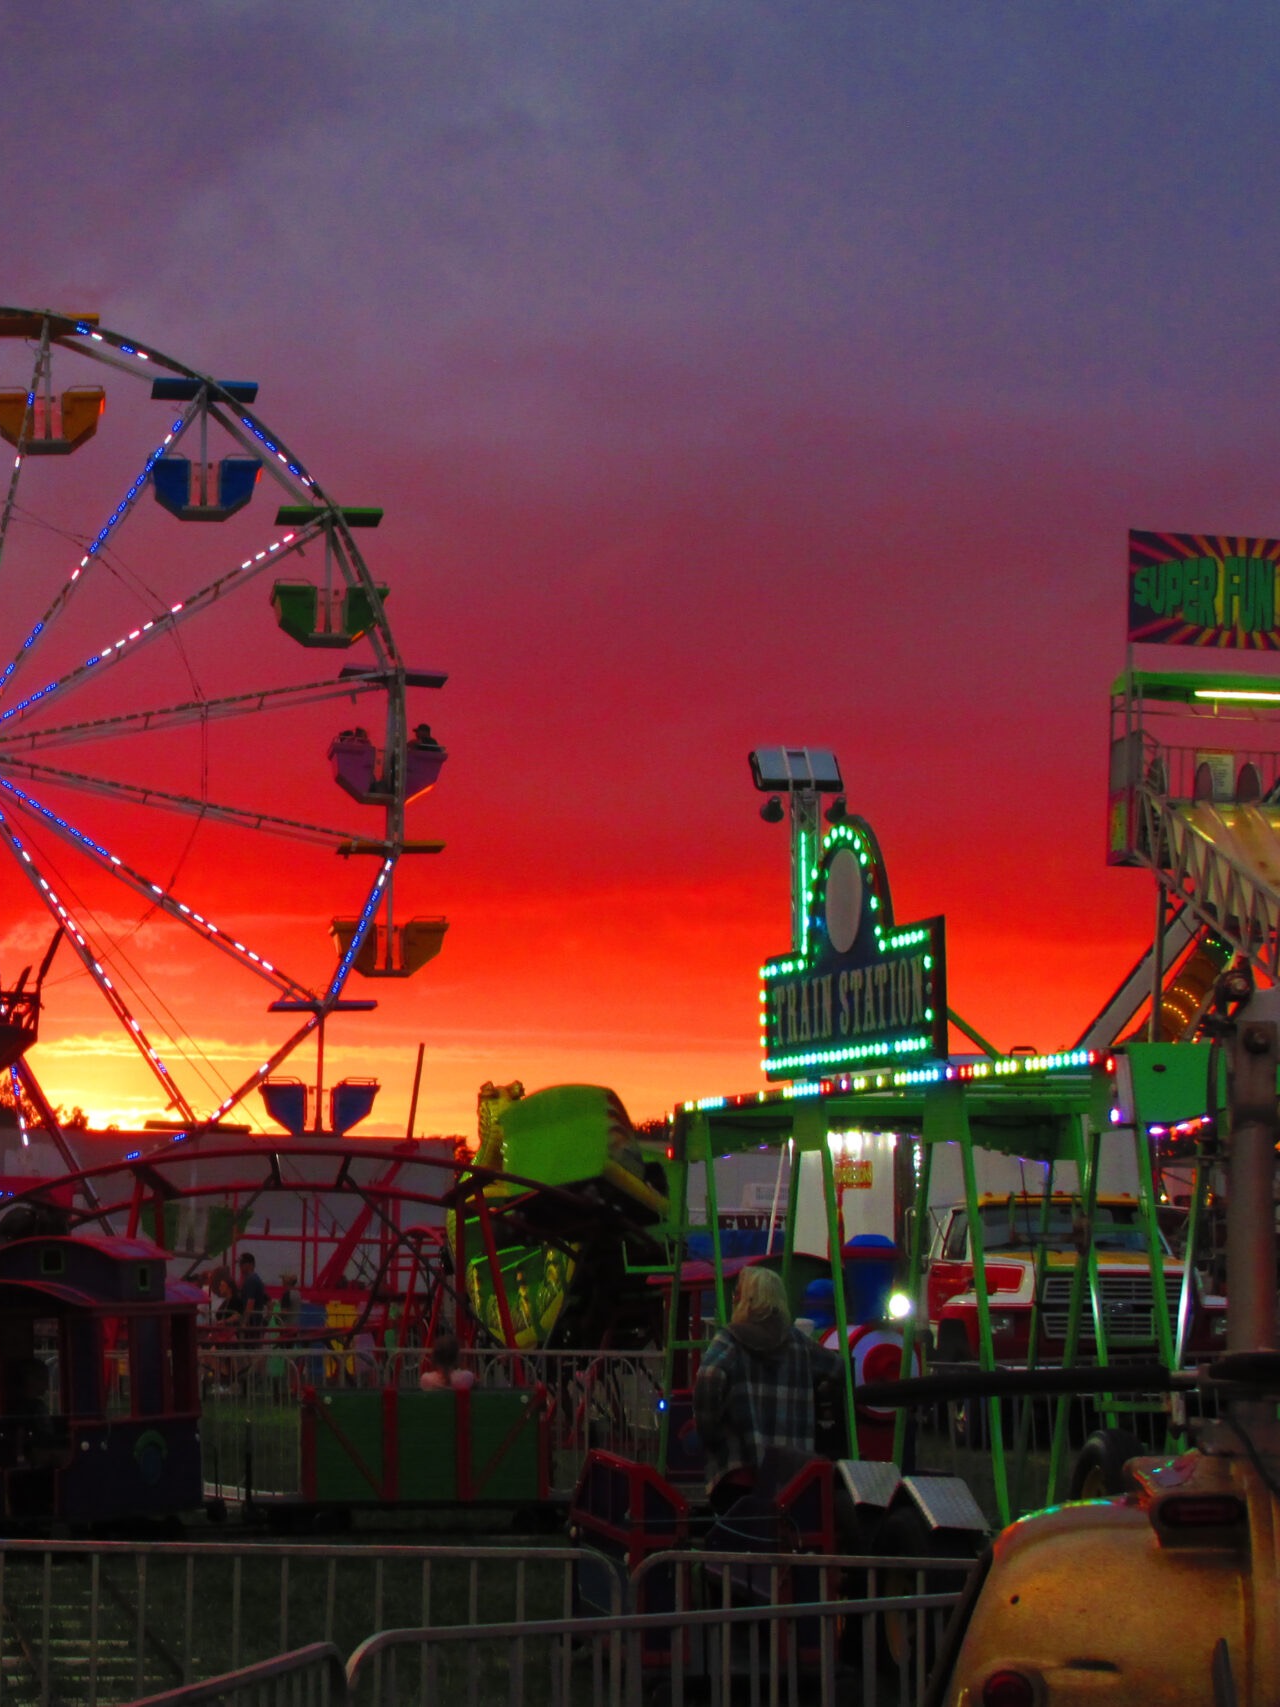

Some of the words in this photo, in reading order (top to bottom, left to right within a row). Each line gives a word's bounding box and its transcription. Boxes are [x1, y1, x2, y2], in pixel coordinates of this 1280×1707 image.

[1134, 556, 1217, 630] SUPER
[1223, 556, 1274, 633] FUN
[774, 972, 833, 1046] TRAIN
[838, 955, 924, 1036] STATION
